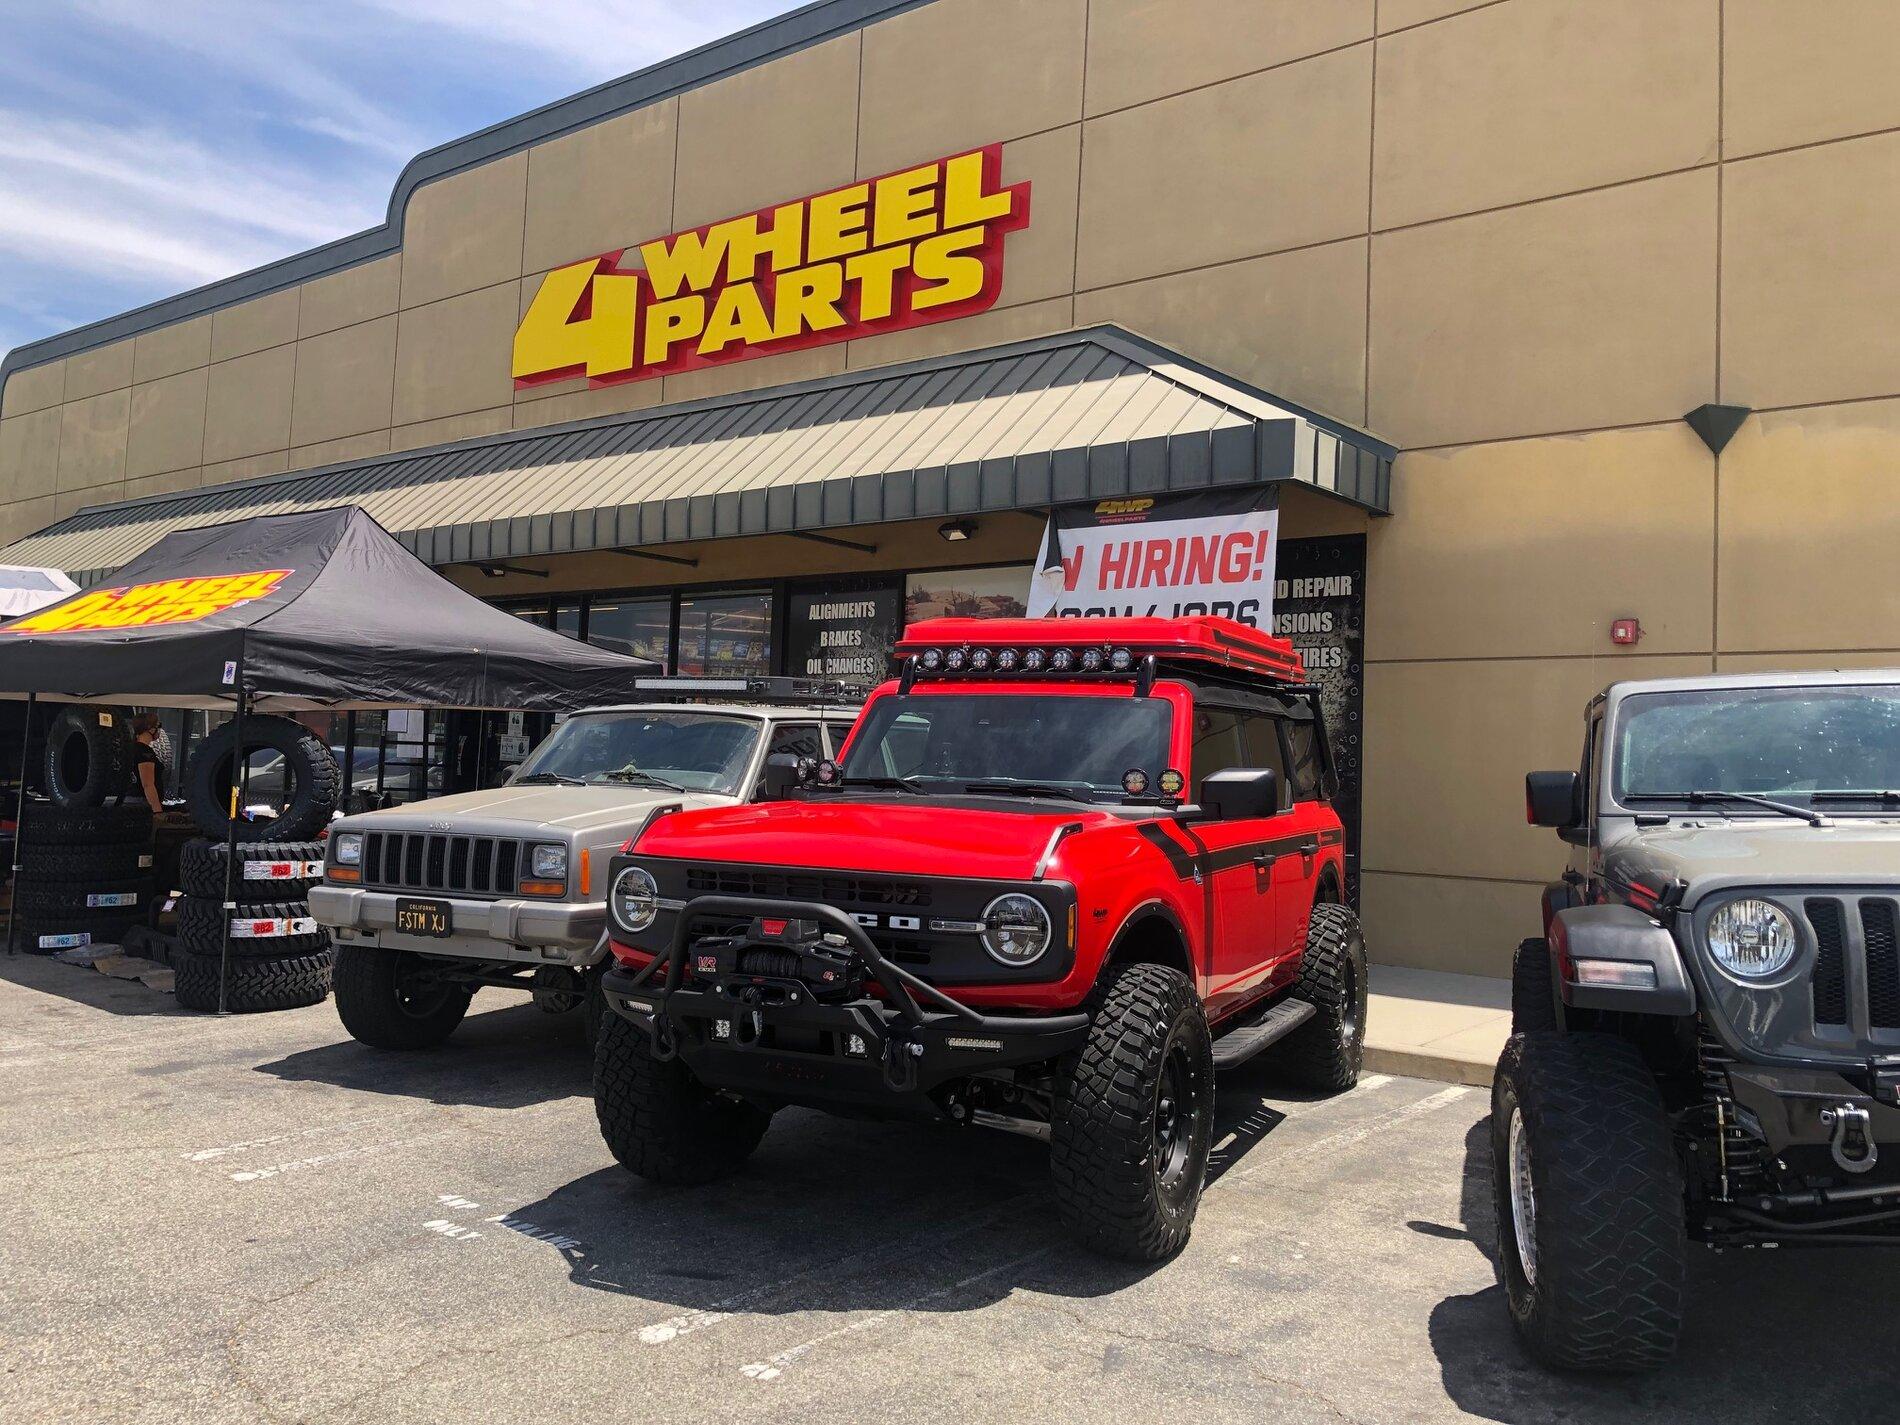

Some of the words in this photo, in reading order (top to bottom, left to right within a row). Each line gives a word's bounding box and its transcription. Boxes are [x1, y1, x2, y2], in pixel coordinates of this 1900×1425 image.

[639, 150, 1011, 300] WHEEL
[511, 257, 638, 378] 4
[643, 225, 985, 365] PARTS
[1097, 529, 1269, 591] HIRING!
[1292, 575, 1353, 598] REPAIR
[808, 600, 876, 620] ALIGNMENTS
[1272, 611, 1333, 634] NSIONS
[820, 629, 862, 647] BRAKES
[806, 658, 823, 675] OIL
[825, 657, 874, 675] CHANGES
[398, 911, 426, 930] FSTM
[431, 913, 446, 932] XJ
